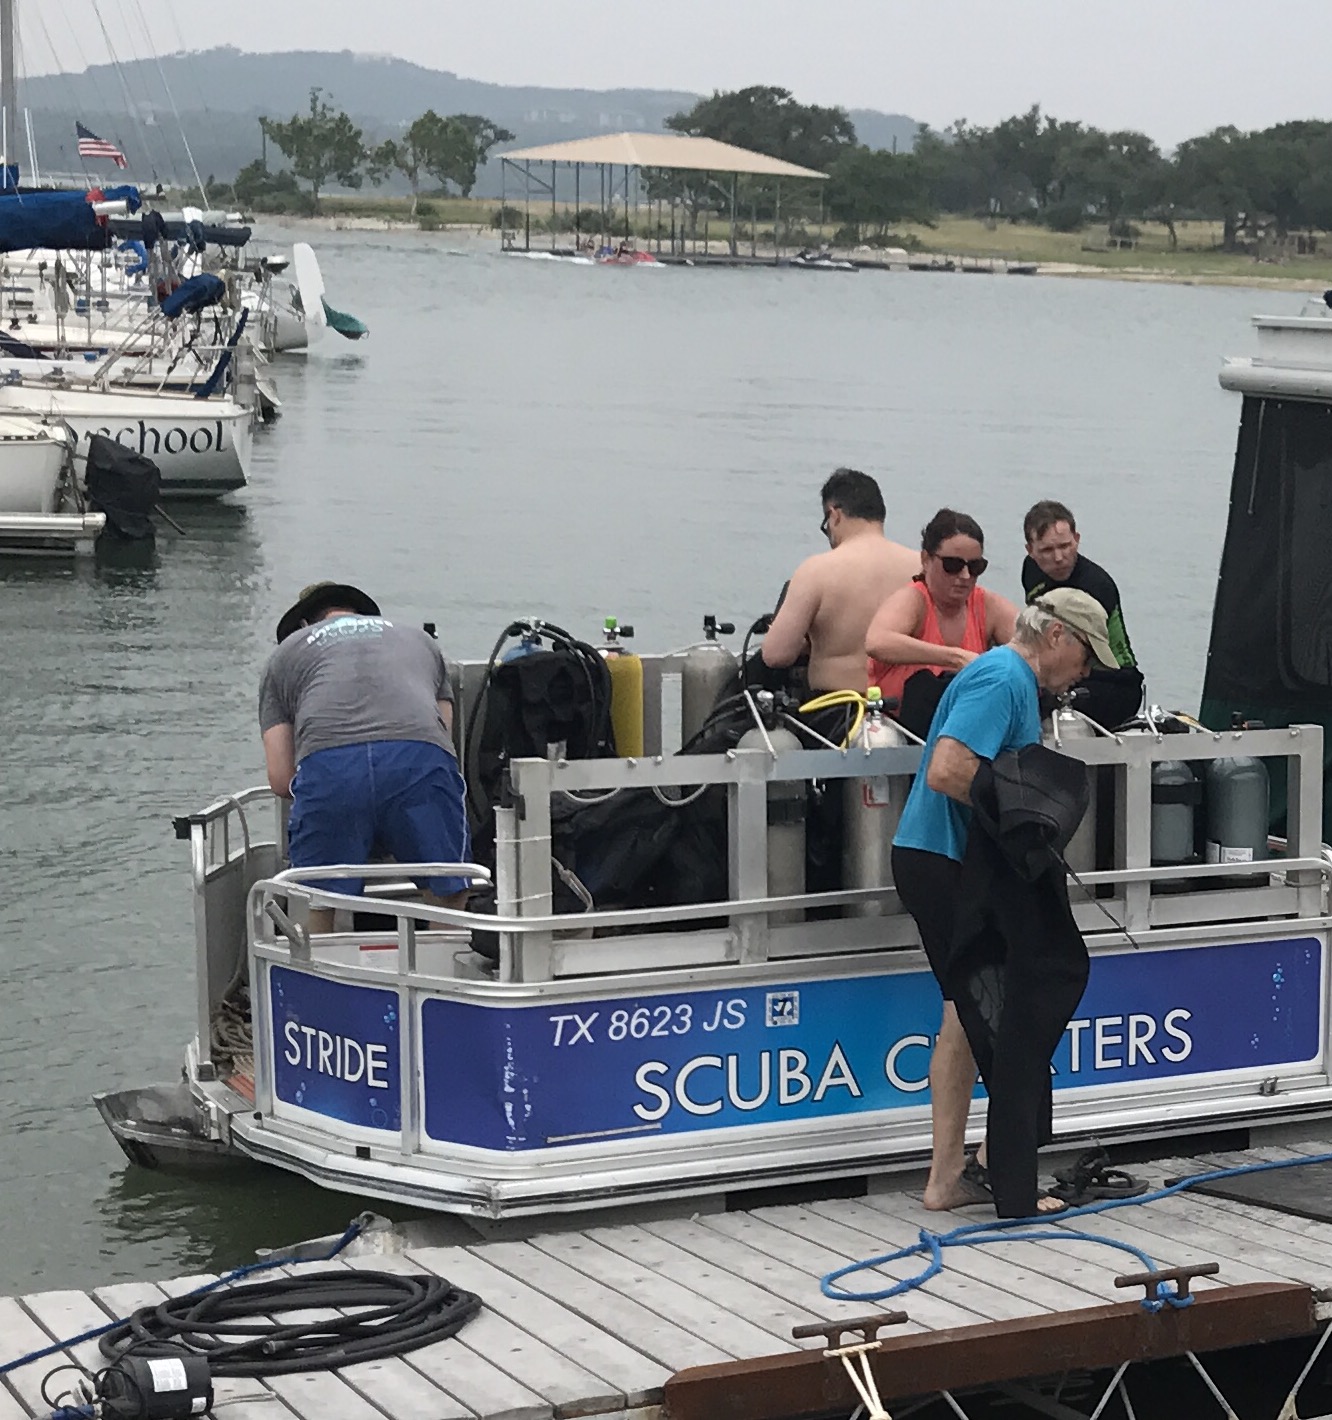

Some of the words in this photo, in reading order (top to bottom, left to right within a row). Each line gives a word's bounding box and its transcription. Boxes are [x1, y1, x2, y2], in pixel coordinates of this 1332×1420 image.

[284, 1021, 389, 1089] STRIDE
[549, 1011, 600, 1047] TX
[608, 1003, 693, 1042] 8623
[702, 998, 748, 1032] JS
[632, 1042, 862, 1122] SCUBA
[885, 1008, 1193, 1093] CTERS
